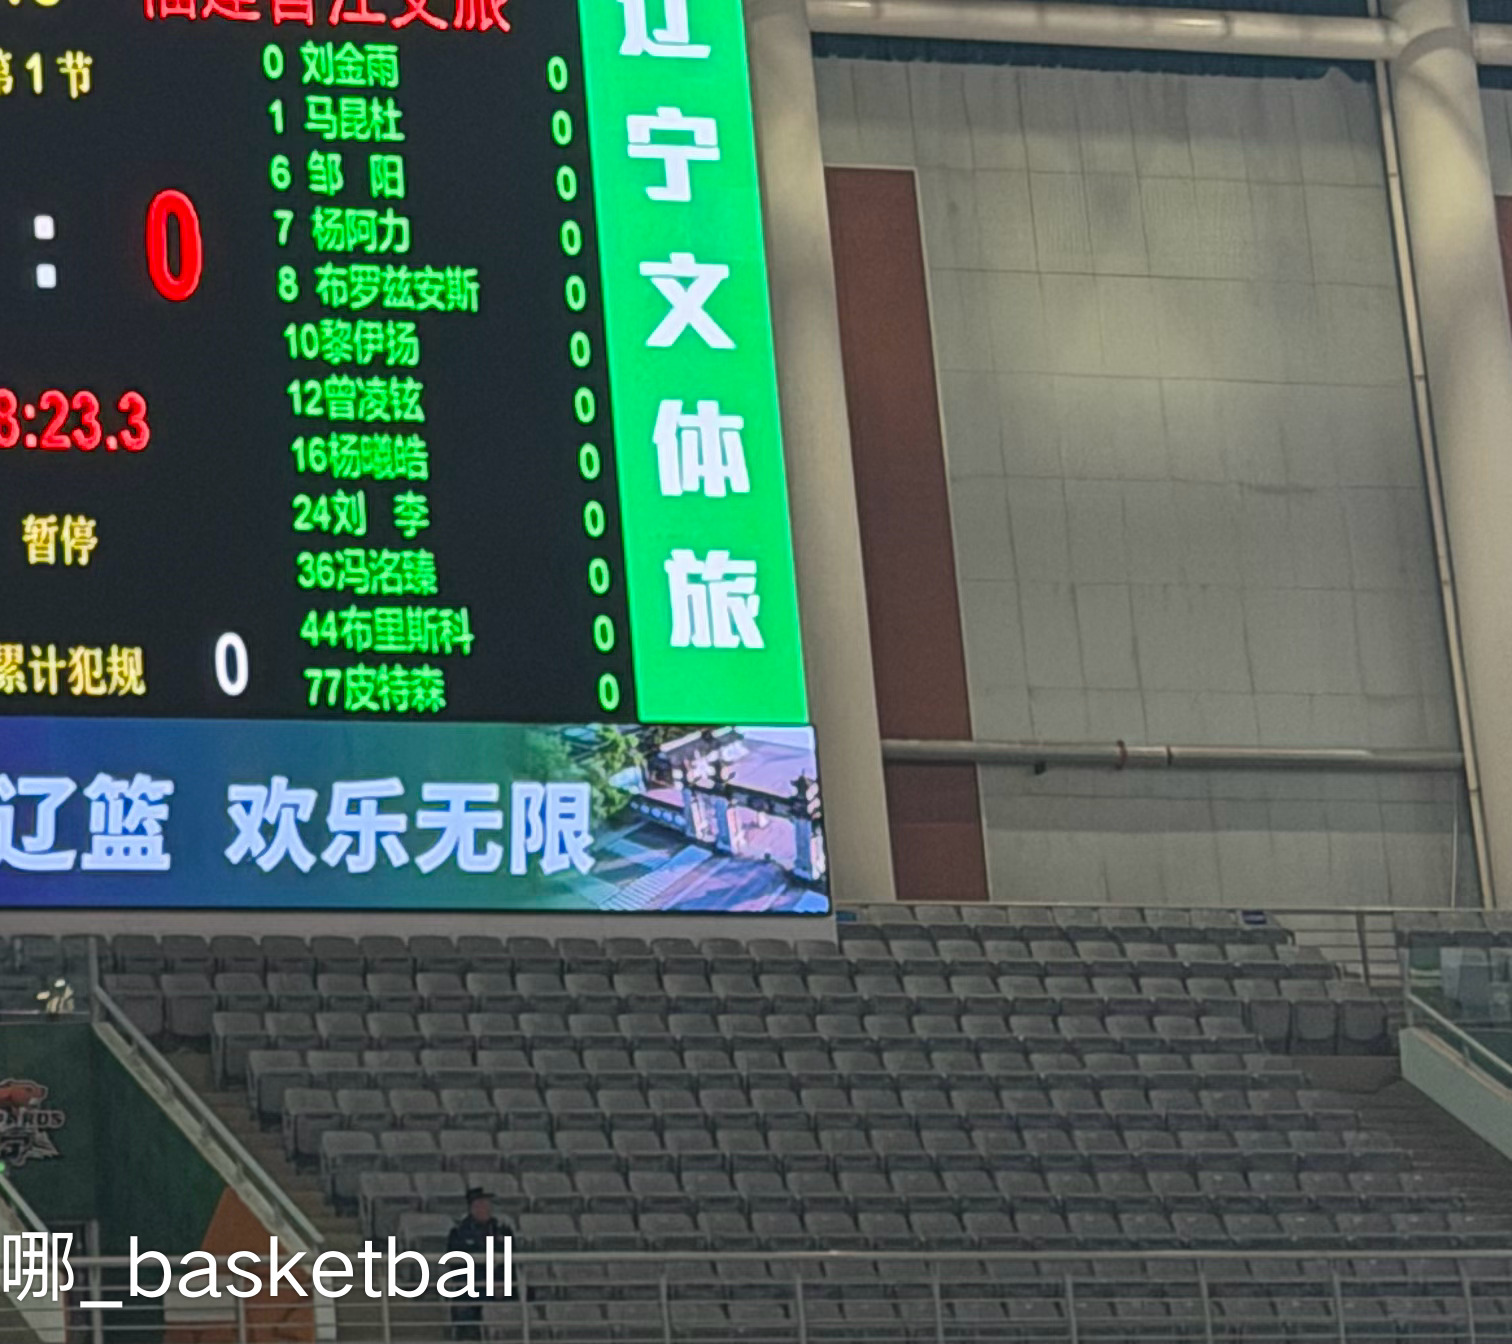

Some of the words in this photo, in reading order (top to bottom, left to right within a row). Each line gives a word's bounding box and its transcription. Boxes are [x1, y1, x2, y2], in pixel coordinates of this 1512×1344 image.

[263, 44, 283, 79] 0
[300, 40, 399, 88] 刘金雨
[548, 56, 568, 92] 0
[269, 100, 283, 134] 1
[304, 95, 405, 142] 马昆杜
[552, 110, 572, 145] 0
[270, 155, 291, 190] 6
[557, 166, 577, 201] 0
[146, 190, 202, 301] 0
[274, 210, 293, 245] 7
[311, 206, 410, 253] 杨阿力
[561, 220, 582, 255] 0
[278, 265, 299, 302] 8
[566, 275, 586, 311] 0
[570, 331, 590, 367] 0
[575, 387, 595, 423] 0
[580, 443, 600, 479] 0
[23, 515, 97, 565] 暂停
[584, 500, 605, 537] 0
[589, 558, 609, 594] 0
[594, 615, 614, 651] 0
[216, 633, 248, 696] 0
[599, 674, 619, 710] 0
[226, 777, 594, 875] 欢乐无限
